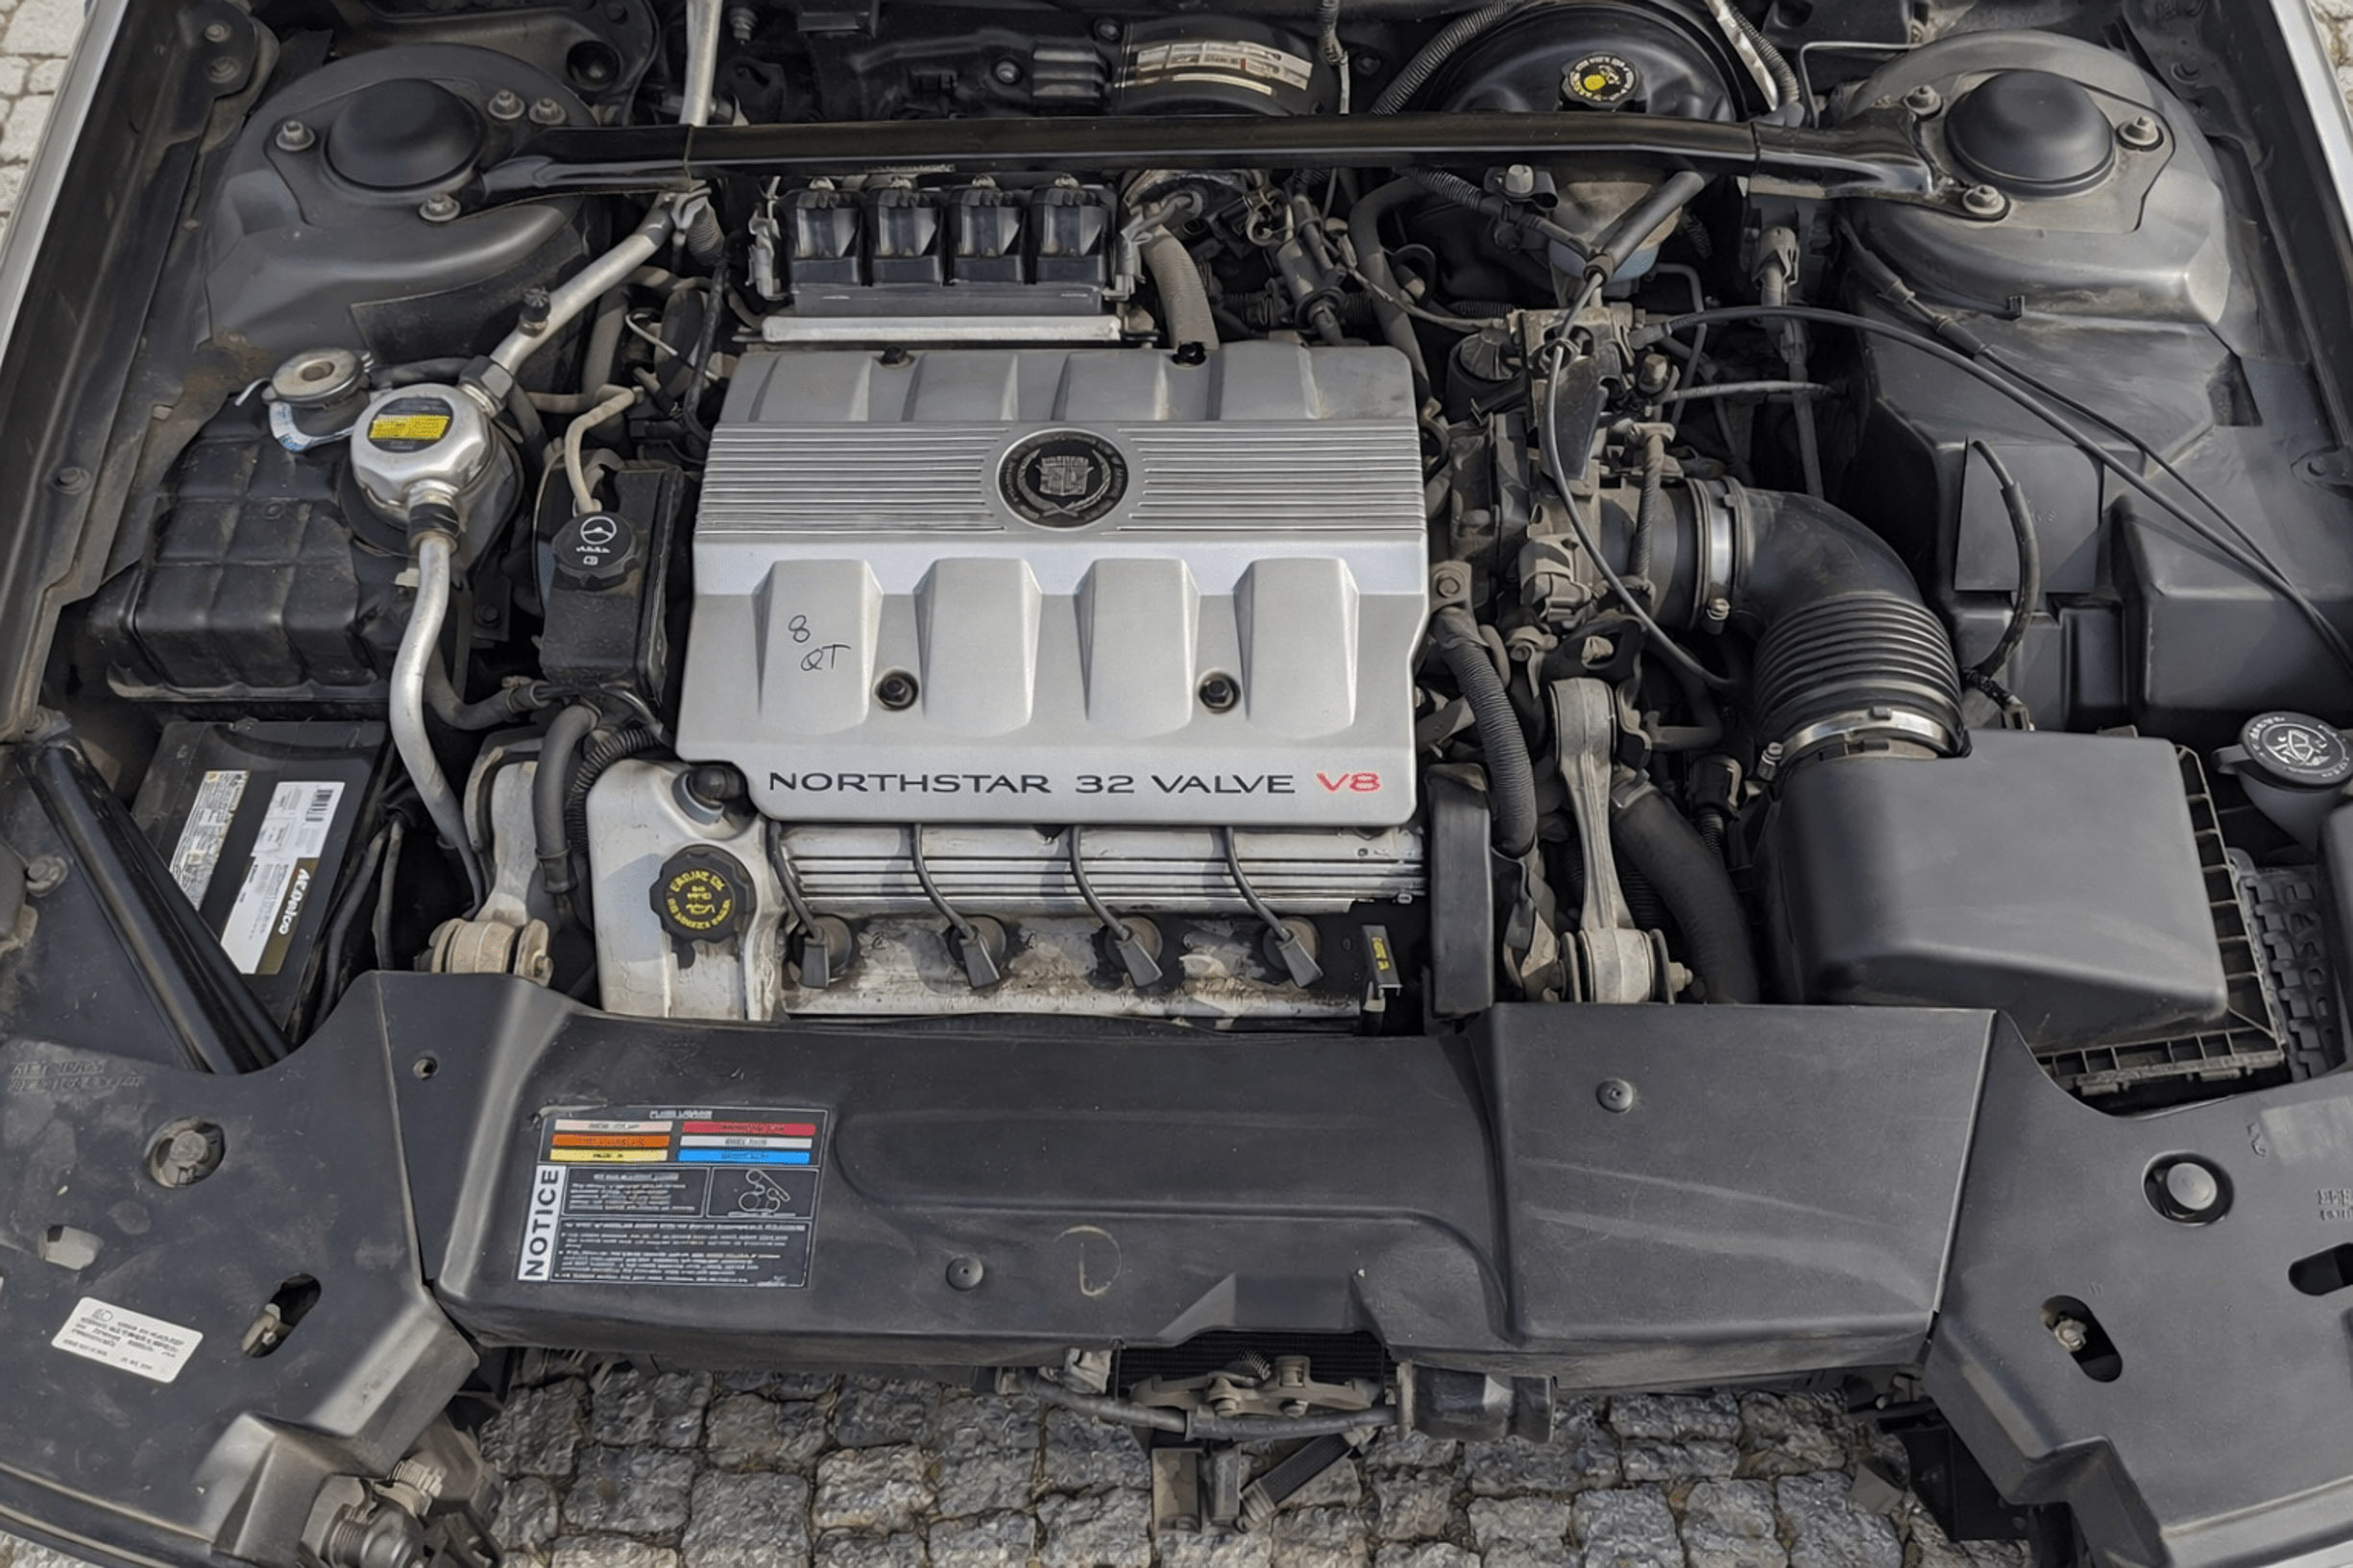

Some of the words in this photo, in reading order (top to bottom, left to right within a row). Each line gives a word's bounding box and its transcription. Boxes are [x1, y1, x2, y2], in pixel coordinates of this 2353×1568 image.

[788, 615, 812, 643] 8
[800, 643, 852, 671] QT
[768, 772, 1052, 794] NORTHSTAR
[1075, 774, 1135, 794] 32
[1151, 774, 1296, 795] VALVE
[1316, 771, 1381, 793] V8
[523, 1169, 560, 1278] NOTICE
